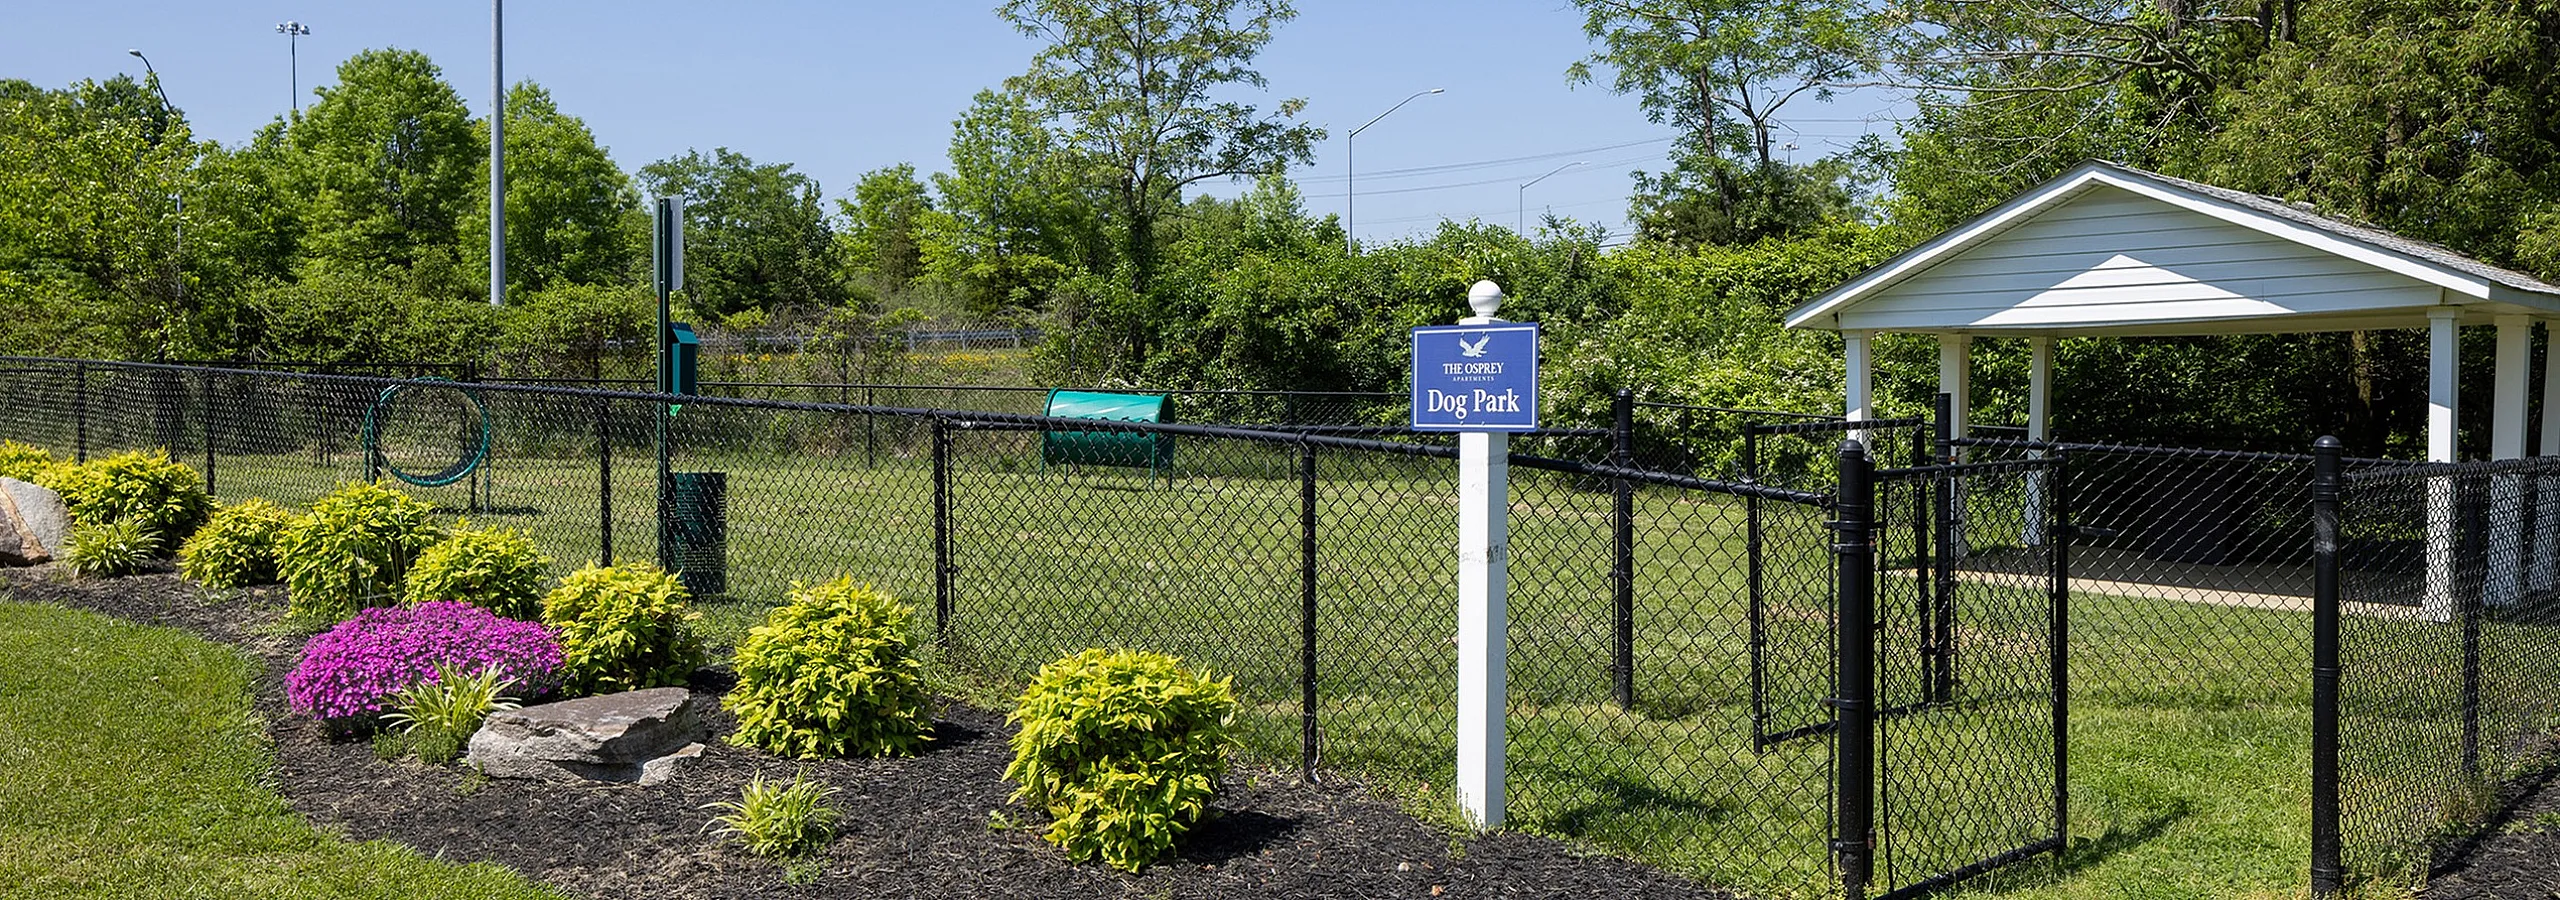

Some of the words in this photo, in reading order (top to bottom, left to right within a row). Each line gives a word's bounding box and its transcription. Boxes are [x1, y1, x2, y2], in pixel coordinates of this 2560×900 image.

[1442, 363, 1463, 375] THE
[1465, 362, 1504, 374] OSPREY
[1427, 389, 1468, 419] Dog
[1473, 388, 1520, 412] Park
